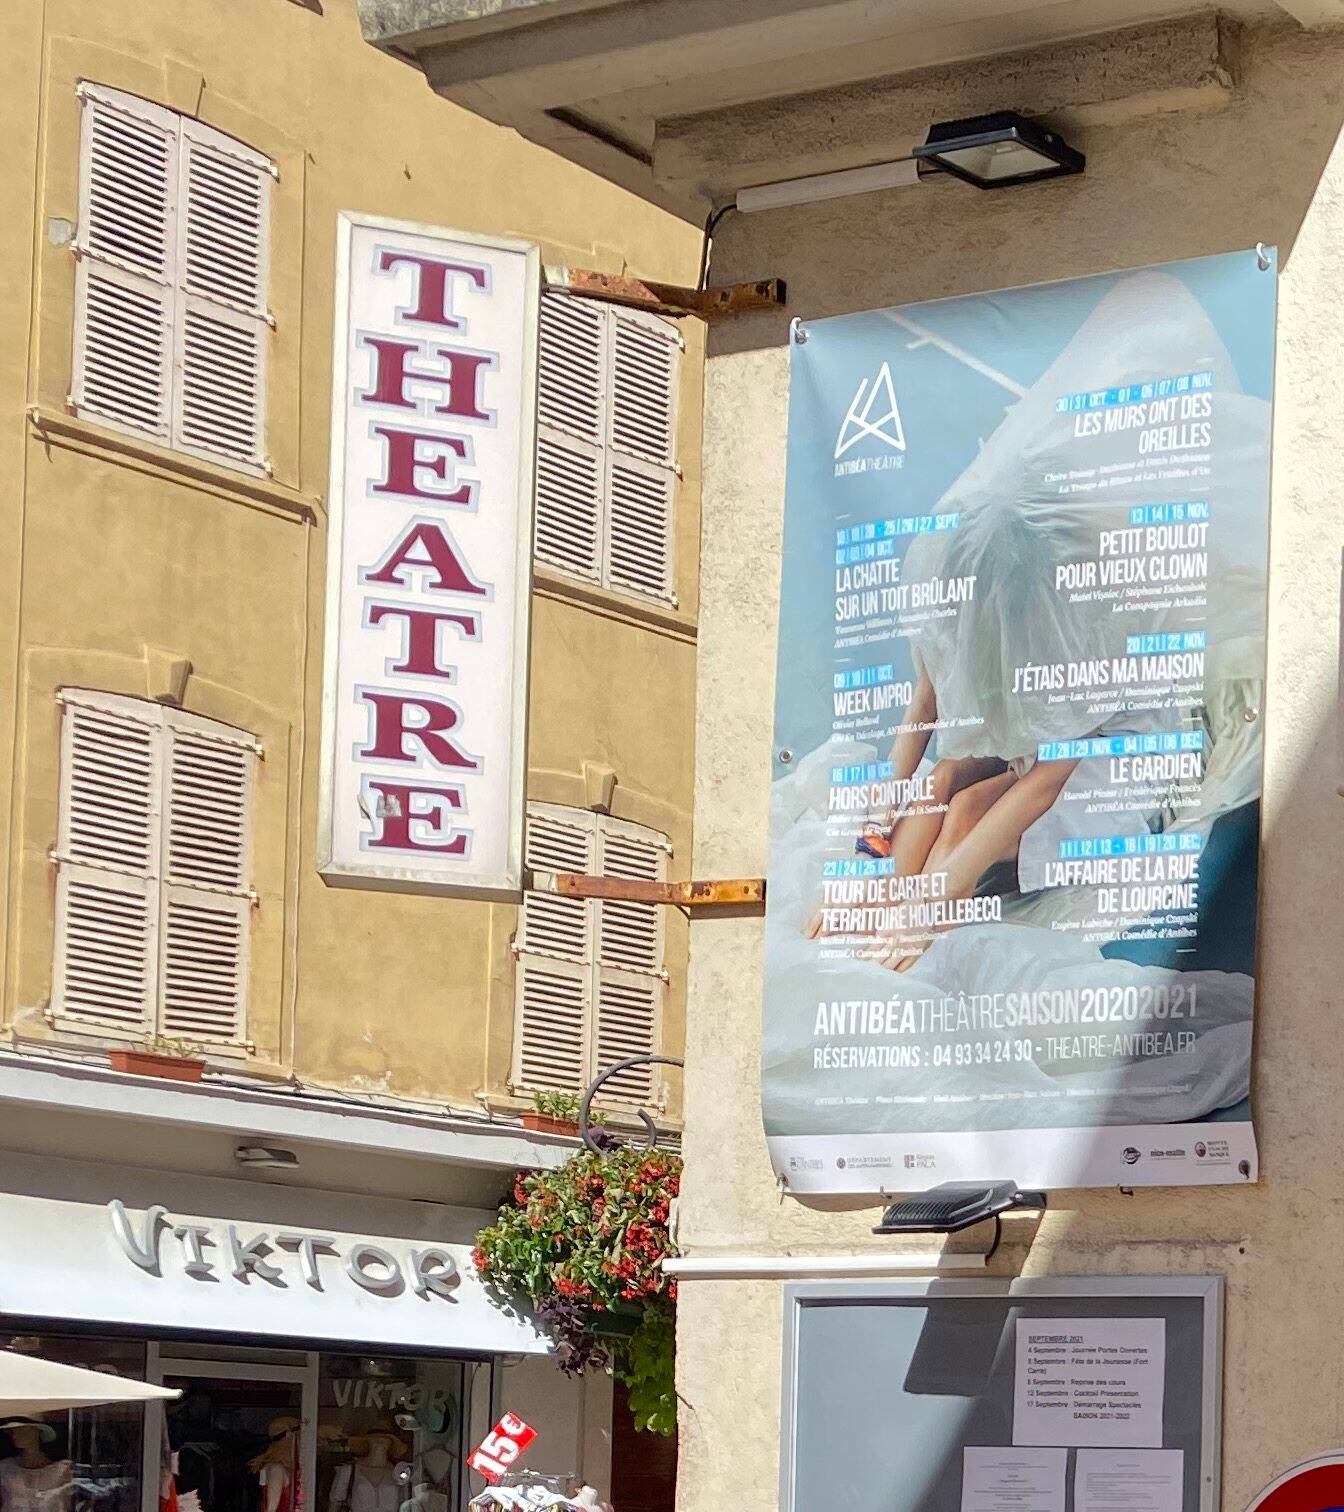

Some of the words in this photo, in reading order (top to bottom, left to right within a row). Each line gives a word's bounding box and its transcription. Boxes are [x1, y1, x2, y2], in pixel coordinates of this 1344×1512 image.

[1074, 411, 1101, 437] LES
[1105, 403, 1147, 432] MURS
[1149, 397, 1178, 424] ONT
[1181, 392, 1212, 420] DES
[1138, 422, 1211, 454] OREILLES
[1188, 502, 1209, 518] NOV.
[361, 250, 493, 855] THEATRE
[1099, 528, 1144, 556] PETIT
[1146, 522, 1209, 552] BOULOT
[836, 567, 851, 592] LA
[853, 558, 900, 590] CHATTE
[1055, 560, 1097, 590] POUR
[1099, 556, 1147, 586] VIEUX
[1149, 552, 1208, 581] CLOWN
[835, 594, 860, 620] SUR
[861, 591, 879, 614] UN
[881, 584, 909, 612] TOIT
[911, 576, 977, 608] BRÛLANT
[1012, 661, 1065, 694] J'ÉTAIS
[1067, 660, 1110, 688] DANS
[1112, 656, 1138, 684] MA
[1142, 652, 1205, 682] MAISON
[833, 690, 871, 717] WEEK
[873, 681, 913, 711] IMPRO
[1110, 758, 1129, 784] LE
[1131, 752, 1201, 782] GARDIEN
[829, 785, 868, 810] HORS
[821, 879, 865, 904] TOUR
[867, 878, 886, 903] DE
[888, 874, 930, 900] CARTE
[931, 872, 948, 897] ET
[1045, 858, 1118, 887] L'AFFAIRE
[1120, 857, 1143, 883] DE
[1144, 856, 1165, 882] LA
[1168, 854, 1200, 880] RUE
[820, 905, 907, 932] TERRITOIRE
[909, 895, 1002, 929] HOUELLEBECQ
[1098, 888, 1119, 914] DE
[1121, 883, 1199, 913] LOURCINE
[1121, 928, 1158, 940] Comédie
[813, 1043, 921, 1069] RÉSERVATIONS
[933, 1044, 951, 1066] 04
[955, 1042, 972, 1065] 93
[975, 1040, 991, 1064] 34
[994, 1040, 1010, 1062] 24
[1014, 1038, 1033, 1061] 30
[1046, 1031, 1197, 1060] THEATRE-ANTIBEA.FR
[107, 1199, 461, 1295] VIKTOR
[472, 1412, 526, 1475] 15€
